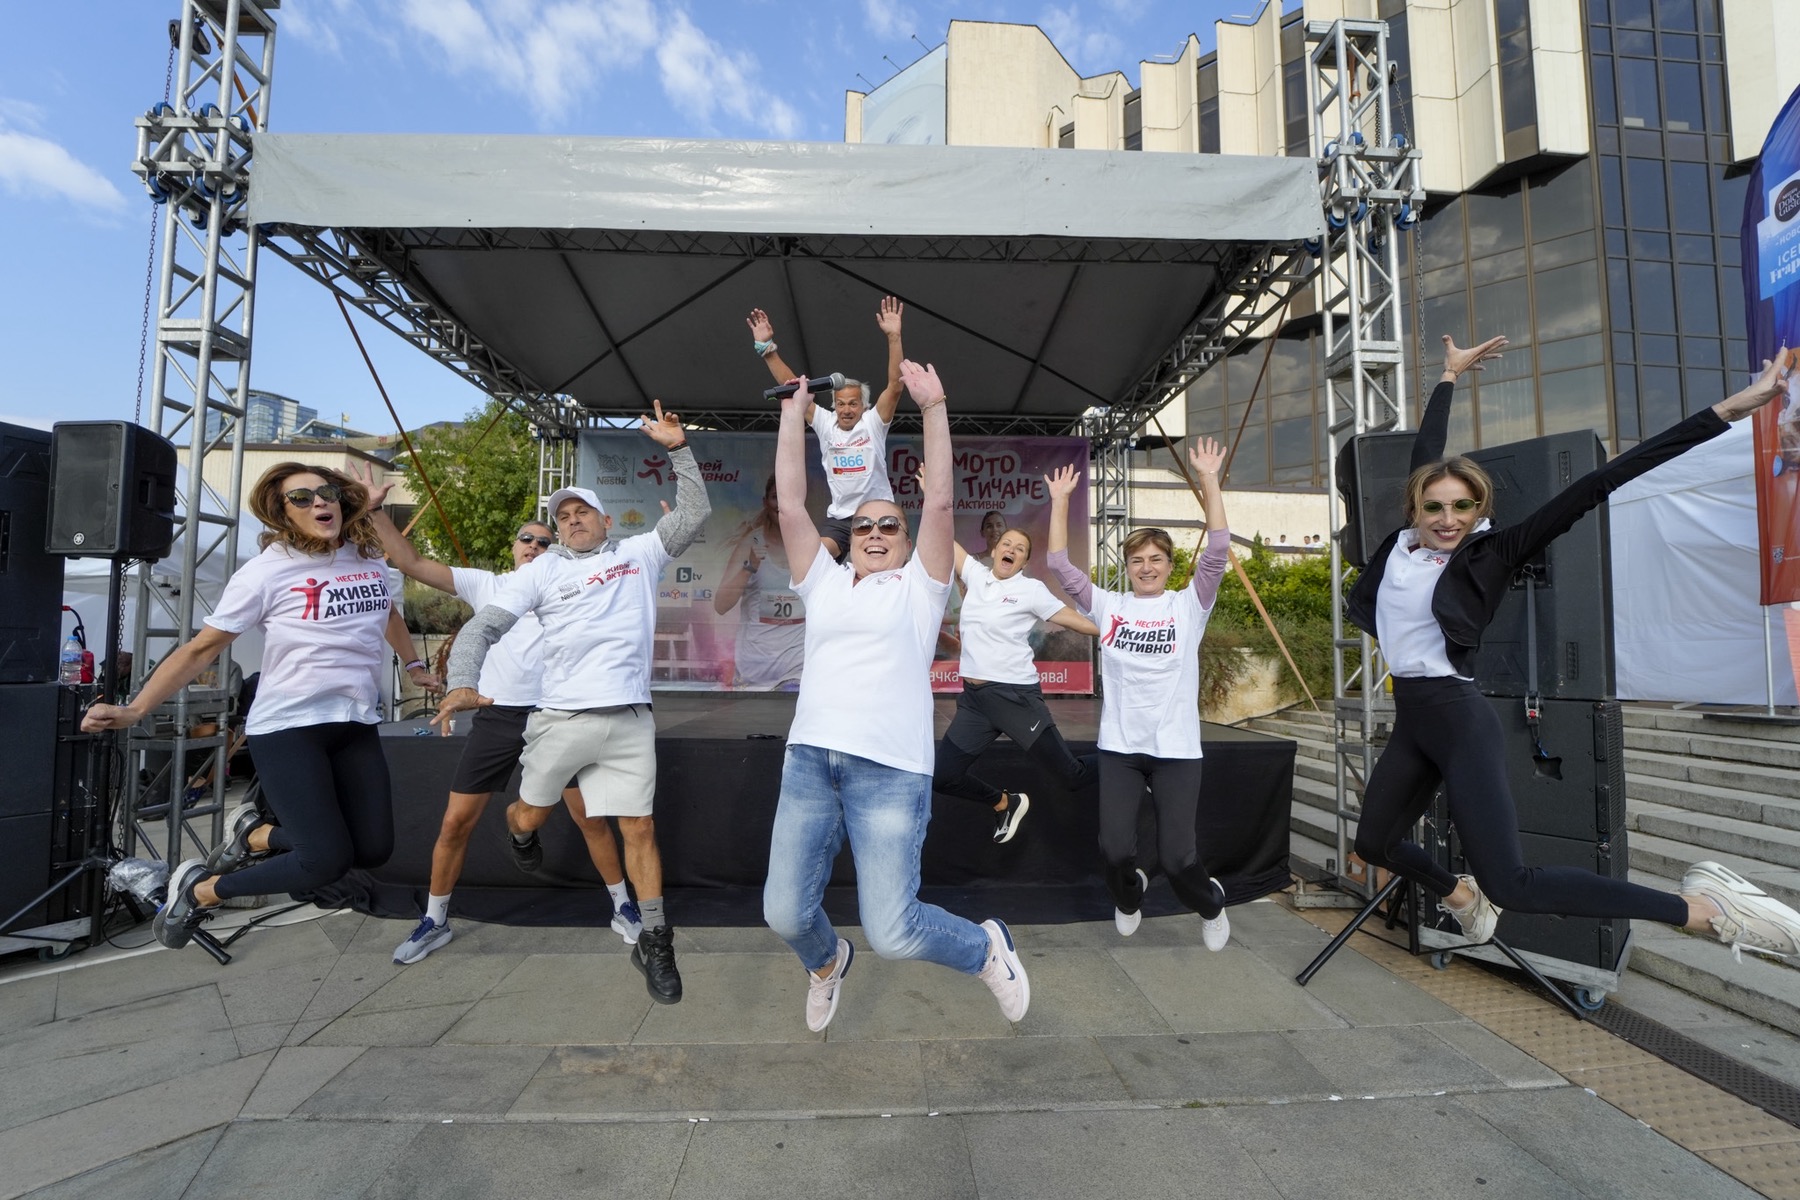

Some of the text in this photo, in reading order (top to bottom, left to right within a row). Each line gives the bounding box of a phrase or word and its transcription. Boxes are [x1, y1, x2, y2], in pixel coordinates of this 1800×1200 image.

[833, 454, 864, 467] 1866
[892, 449, 1016, 477] ГОМОТО
[335, 571, 382, 583] НЕСТЛЕ ЗА
[326, 580, 389, 603] ЖИВЕЙ
[774, 603, 792, 617] 20
[1135, 619, 1166, 629] НЕСТЛЕ
[1118, 625, 1176, 642] ЖИВЕЙ
[1113, 639, 1176, 654] АКТИВНО!
[929, 668, 1068, 684] ачка ява!
